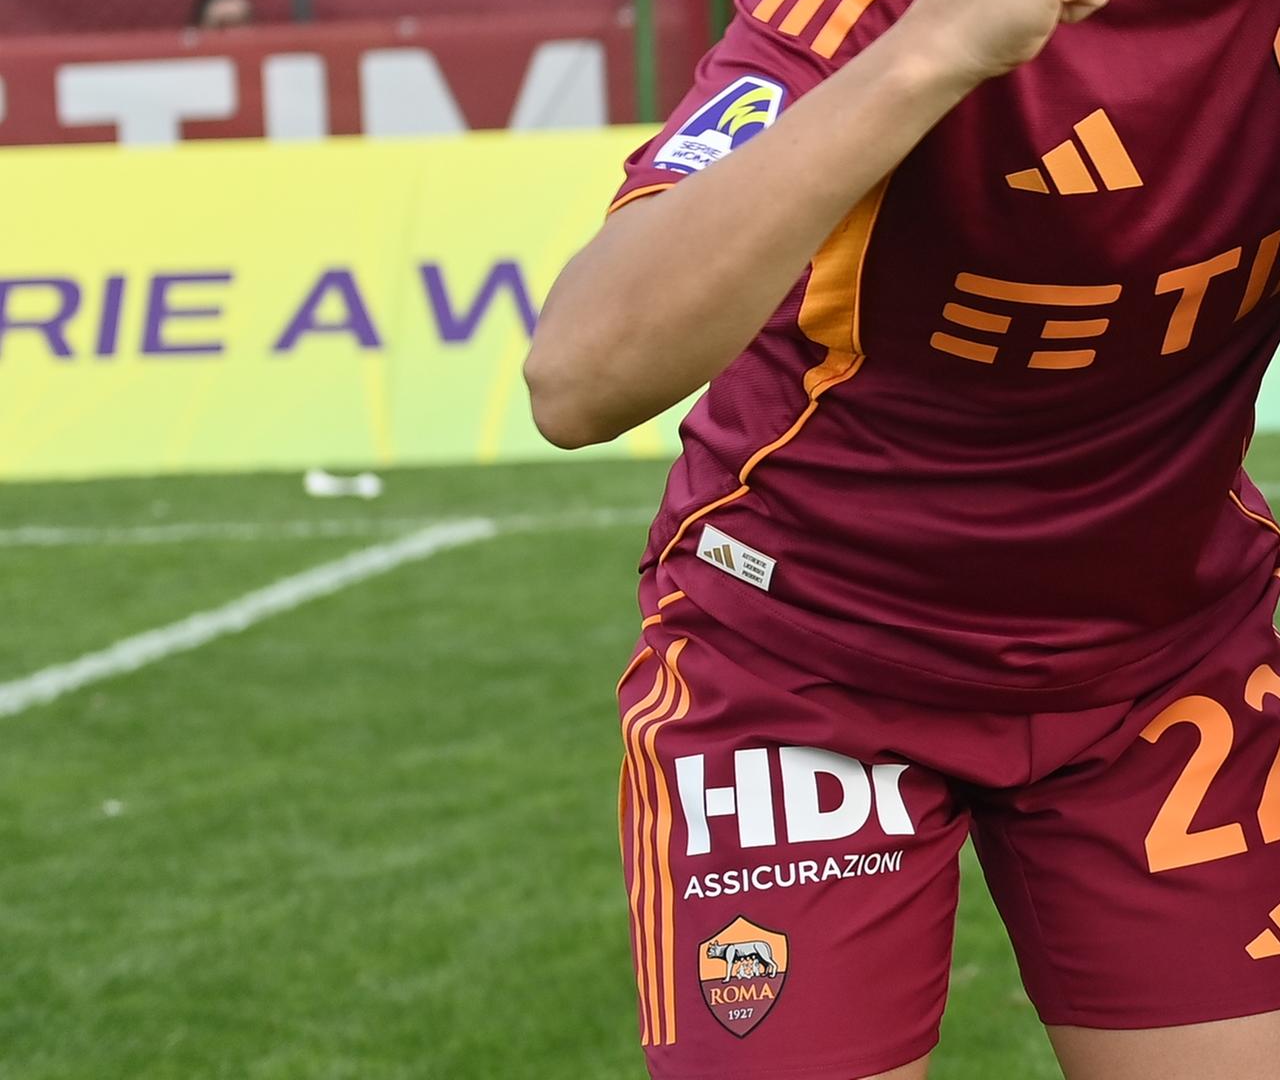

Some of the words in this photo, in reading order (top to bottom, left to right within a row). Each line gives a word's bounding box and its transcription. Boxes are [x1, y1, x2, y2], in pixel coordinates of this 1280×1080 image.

[672, 150, 712, 166] WOM
[270, 268, 383, 354] A
[416, 259, 538, 344] W
[674, 746, 916, 857] HDI
[683, 850, 903, 900] ASSICURAZIONI
[709, 982, 775, 1006] ROMA
[728, 1008, 754, 1020] 1927
